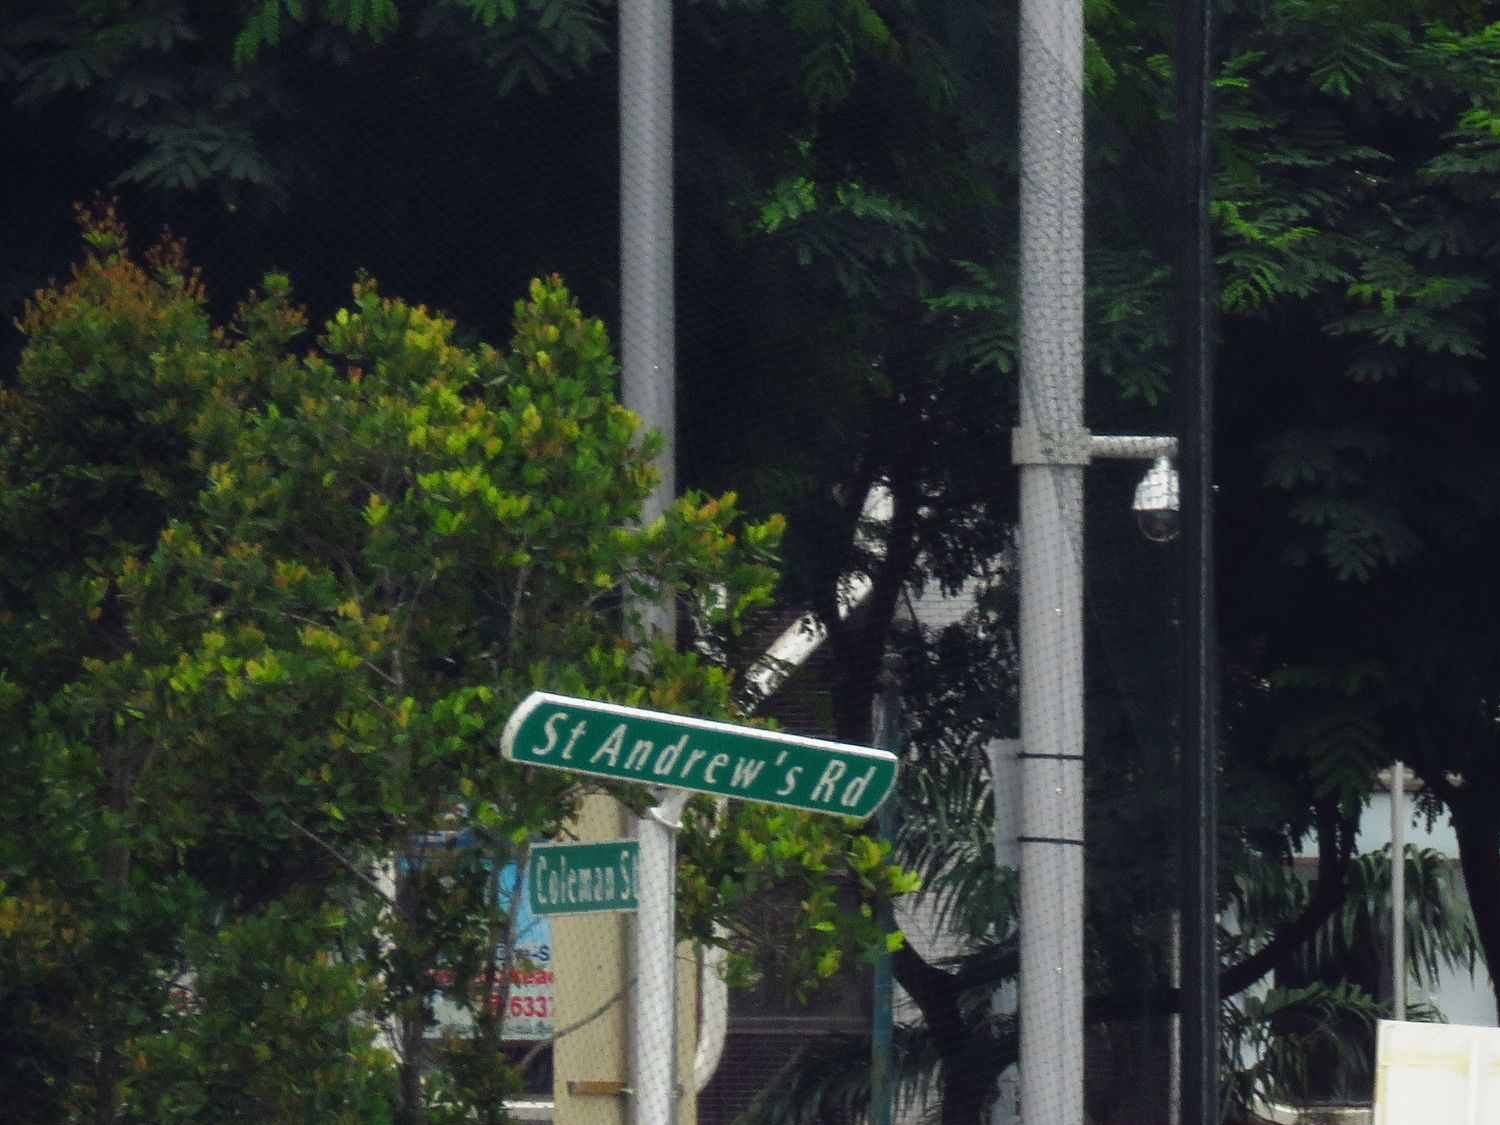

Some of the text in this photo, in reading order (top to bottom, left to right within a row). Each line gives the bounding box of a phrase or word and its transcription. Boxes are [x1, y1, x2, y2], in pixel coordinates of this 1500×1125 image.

[532, 712, 876, 807] St Andrew's Rd
[536, 855, 615, 905] Coleman
[511, 996, 556, 1017] 633
